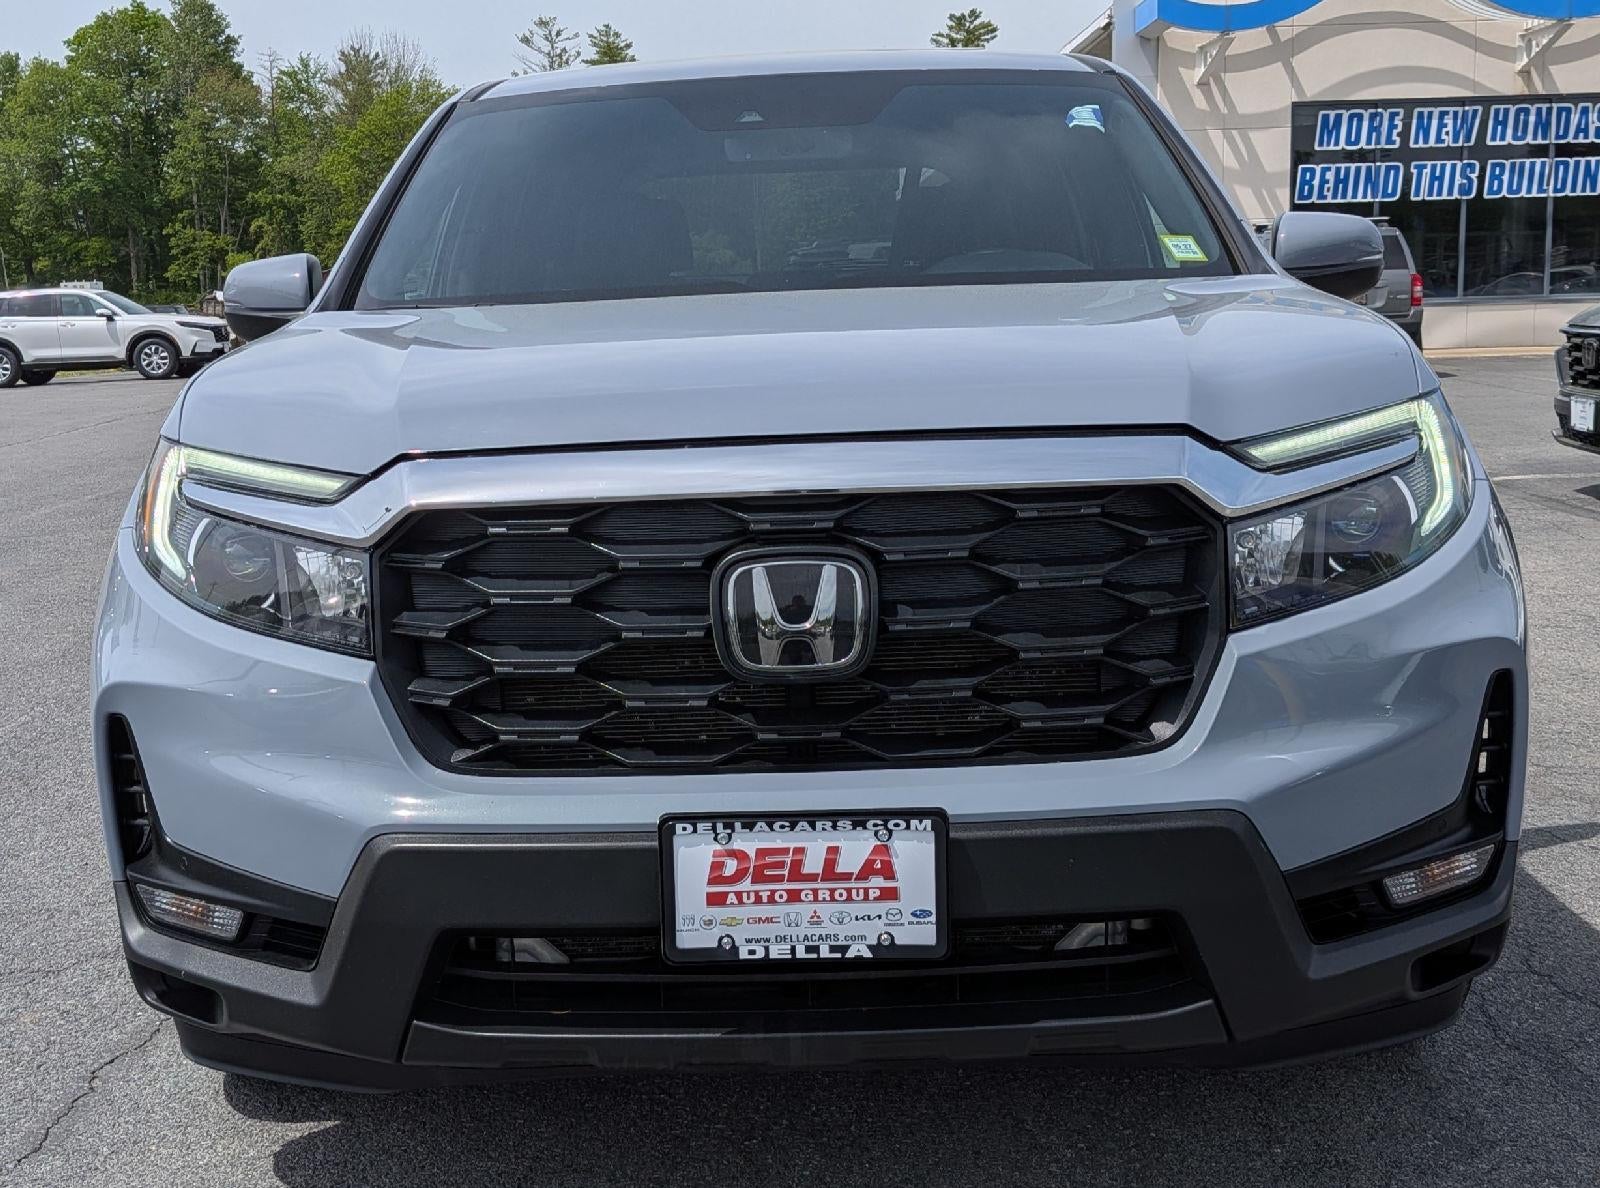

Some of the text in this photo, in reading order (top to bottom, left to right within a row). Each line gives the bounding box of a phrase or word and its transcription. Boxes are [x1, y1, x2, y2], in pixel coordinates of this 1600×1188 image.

[1314, 109, 1404, 150] MORE
[1409, 106, 1483, 148] NEW
[1294, 162, 1403, 203] BEHIND
[1410, 160, 1480, 200] THIS
[675, 819, 932, 835] DELLACARS.COM
[706, 843, 899, 886] DELLA
[725, 888, 882, 905] AUTO GROUP
[747, 916, 781, 925] GMC
[744, 933, 867, 944] www.DELLACARS.com
[739, 943, 874, 959] DELLA
